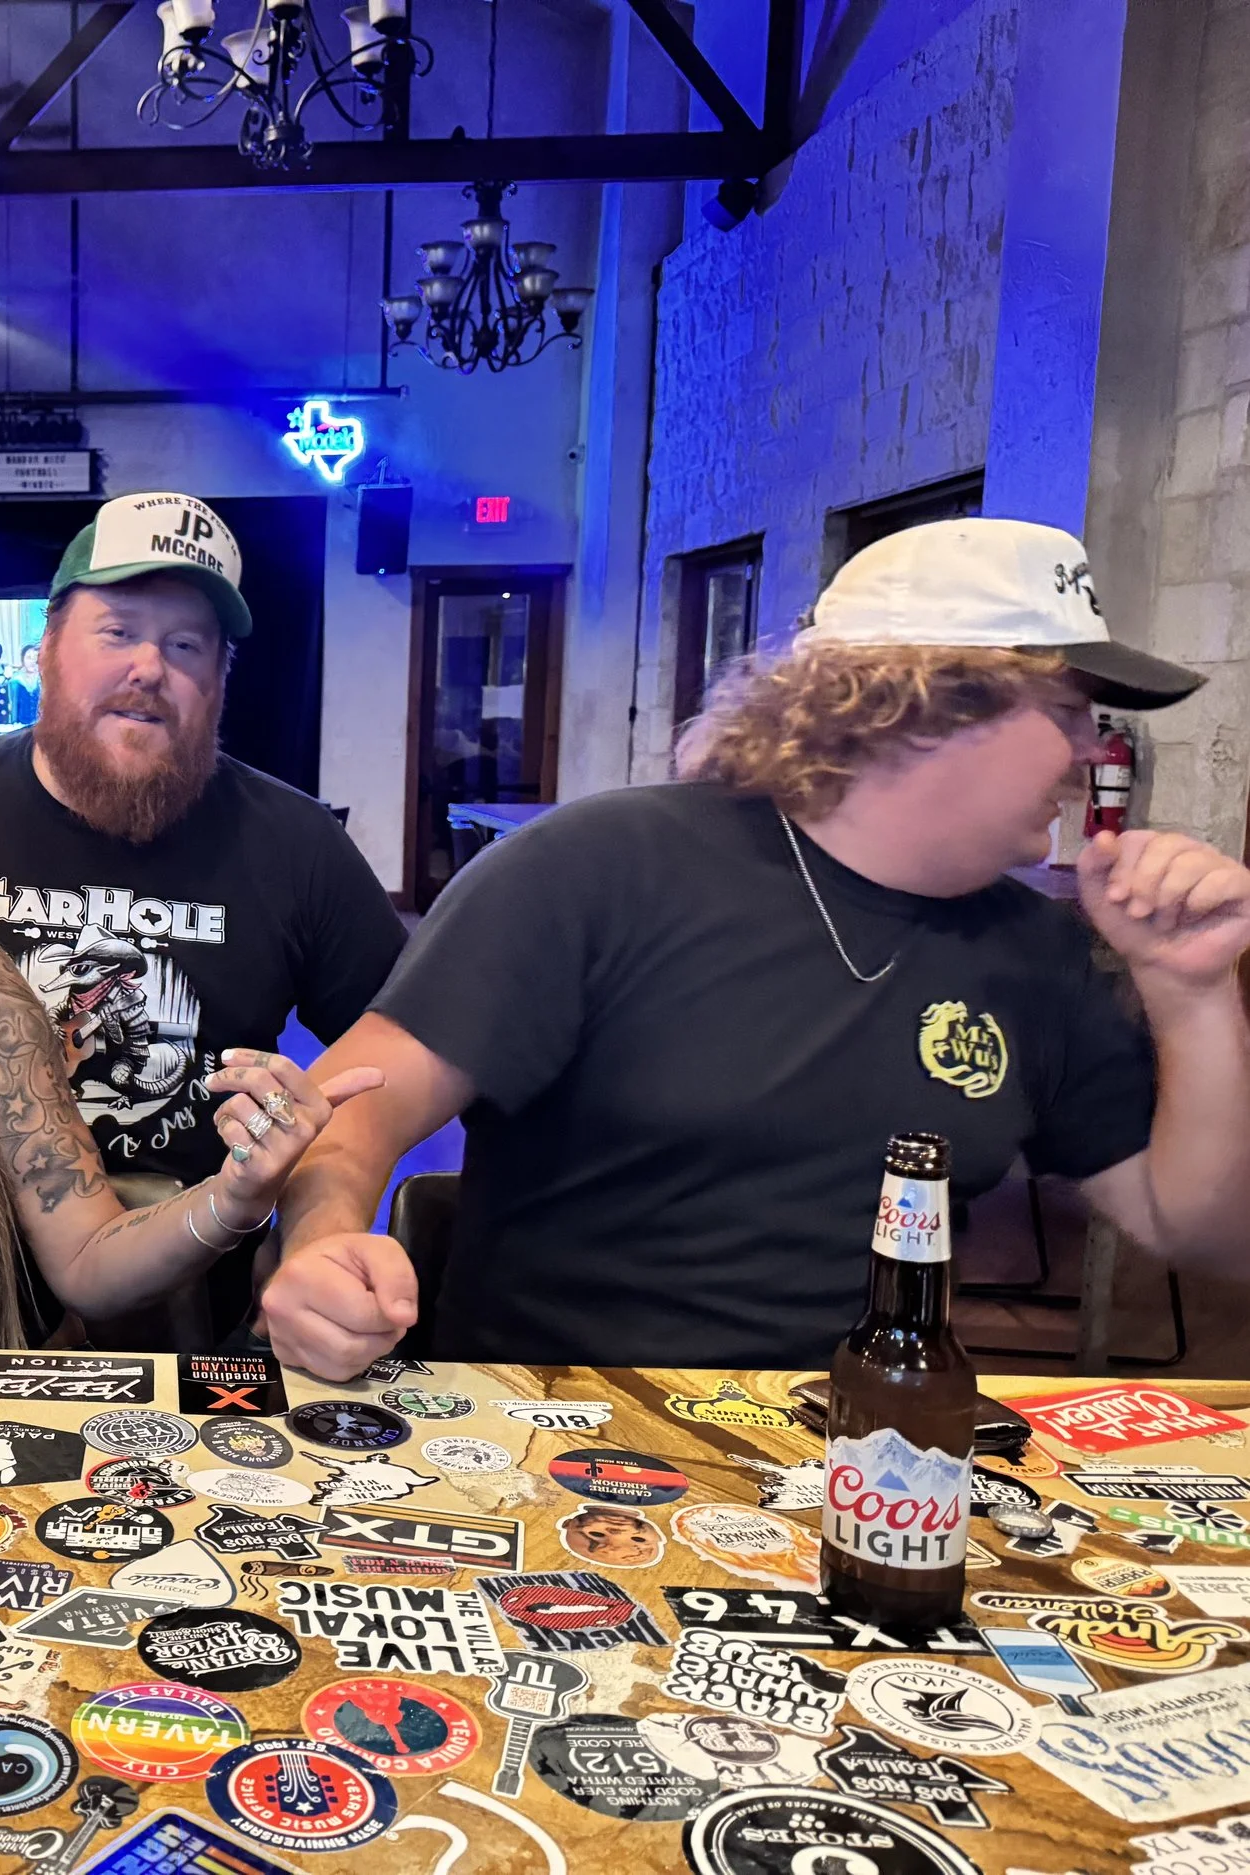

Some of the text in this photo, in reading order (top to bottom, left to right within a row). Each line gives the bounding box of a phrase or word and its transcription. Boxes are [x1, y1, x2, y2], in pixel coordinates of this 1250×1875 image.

[134, 498, 181, 511] WHERE
[186, 499, 207, 513] THE
[477, 497, 510, 523] EXIT
[175, 510, 213, 541] JP
[47, 930, 80, 939] WEST
[151, 1106, 195, 1149] My
[877, 1196, 941, 1231] Coors
[876, 1222, 934, 1246] LIGHT
[191, 1355, 263, 1363] XOVERLAND.COM
[191, 1362, 266, 1374] OVERLAND
[192, 1371, 266, 1381] expedition
[206, 1386, 261, 1411] X
[298, 1402, 362, 1420] GRANDE
[532, 1415, 590, 1428] BIG
[704, 1409, 773, 1420] WILSON
[110, 1426, 170, 1441] YETI
[1091, 1412, 1229, 1441] WHAT A
[352, 1484, 393, 1493] BOYS
[589, 1485, 652, 1497] CAMPFIRE
[591, 1479, 647, 1490] KINGDOM
[829, 1458, 961, 1533] Coors
[1084, 1484, 1149, 1498] FARM
[212, 1518, 296, 1534] TEQUILA
[326, 1513, 510, 1557] GTX
[222, 1533, 303, 1549] DOS RIOS
[835, 1515, 951, 1561] LIGHT
[6, 1567, 69, 1579] MUSIC
[142, 1582, 200, 1597] TEQUILA
[279, 1581, 445, 1613] MUSIC
[476, 1573, 563, 1603] MARILYN
[63, 1602, 130, 1618] BREWING
[452, 1592, 483, 1618] THE
[987, 1598, 1156, 1621] Holleman
[57, 1607, 151, 1633] VISTA
[281, 1607, 456, 1642] LOKAL
[504, 1609, 669, 1651] JACKIE
[1045, 1618, 1241, 1651] Andi
[336, 1641, 466, 1674] LIVE
[683, 1631, 791, 1678] PUB
[507, 1661, 557, 1690] TU
[678, 1655, 839, 1708] WHALE
[896, 1673, 955, 1688] VKM
[967, 1676, 1006, 1696] NEW
[113, 1687, 224, 1715] DALLAS TX
[666, 1675, 828, 1734] BLACK
[1147, 1690, 1224, 1712] COUNTRY
[1095, 1707, 1148, 1724] MUSIC
[86, 1712, 234, 1749] TAVERN
[866, 1706, 1030, 1751] VALKYRIE'S KISS MEAD
[253, 1741, 327, 1753] EST. 1990
[414, 1719, 469, 1768] TEQUILA
[566, 1739, 609, 1748] CODE
[121, 1760, 180, 1777] CITY
[568, 1746, 673, 1774] (512)
[838, 1755, 959, 1782] TEQUILA
[566, 1776, 579, 1785] A
[572, 1785, 703, 1796] GOOD HAS EVER
[581, 1776, 623, 1786] WITH
[625, 1776, 695, 1786] STARTED
[851, 1775, 968, 1803] DOS RIOS
[242, 1776, 363, 1830] TEXAS MUSIC OFFICE
[607, 1796, 681, 1806] NOTHING
[766, 1801, 846, 1814] BY SWORD OR
[230, 1816, 384, 1850] 35TH ANNIVERSARY
[741, 1828, 894, 1849] STONES
